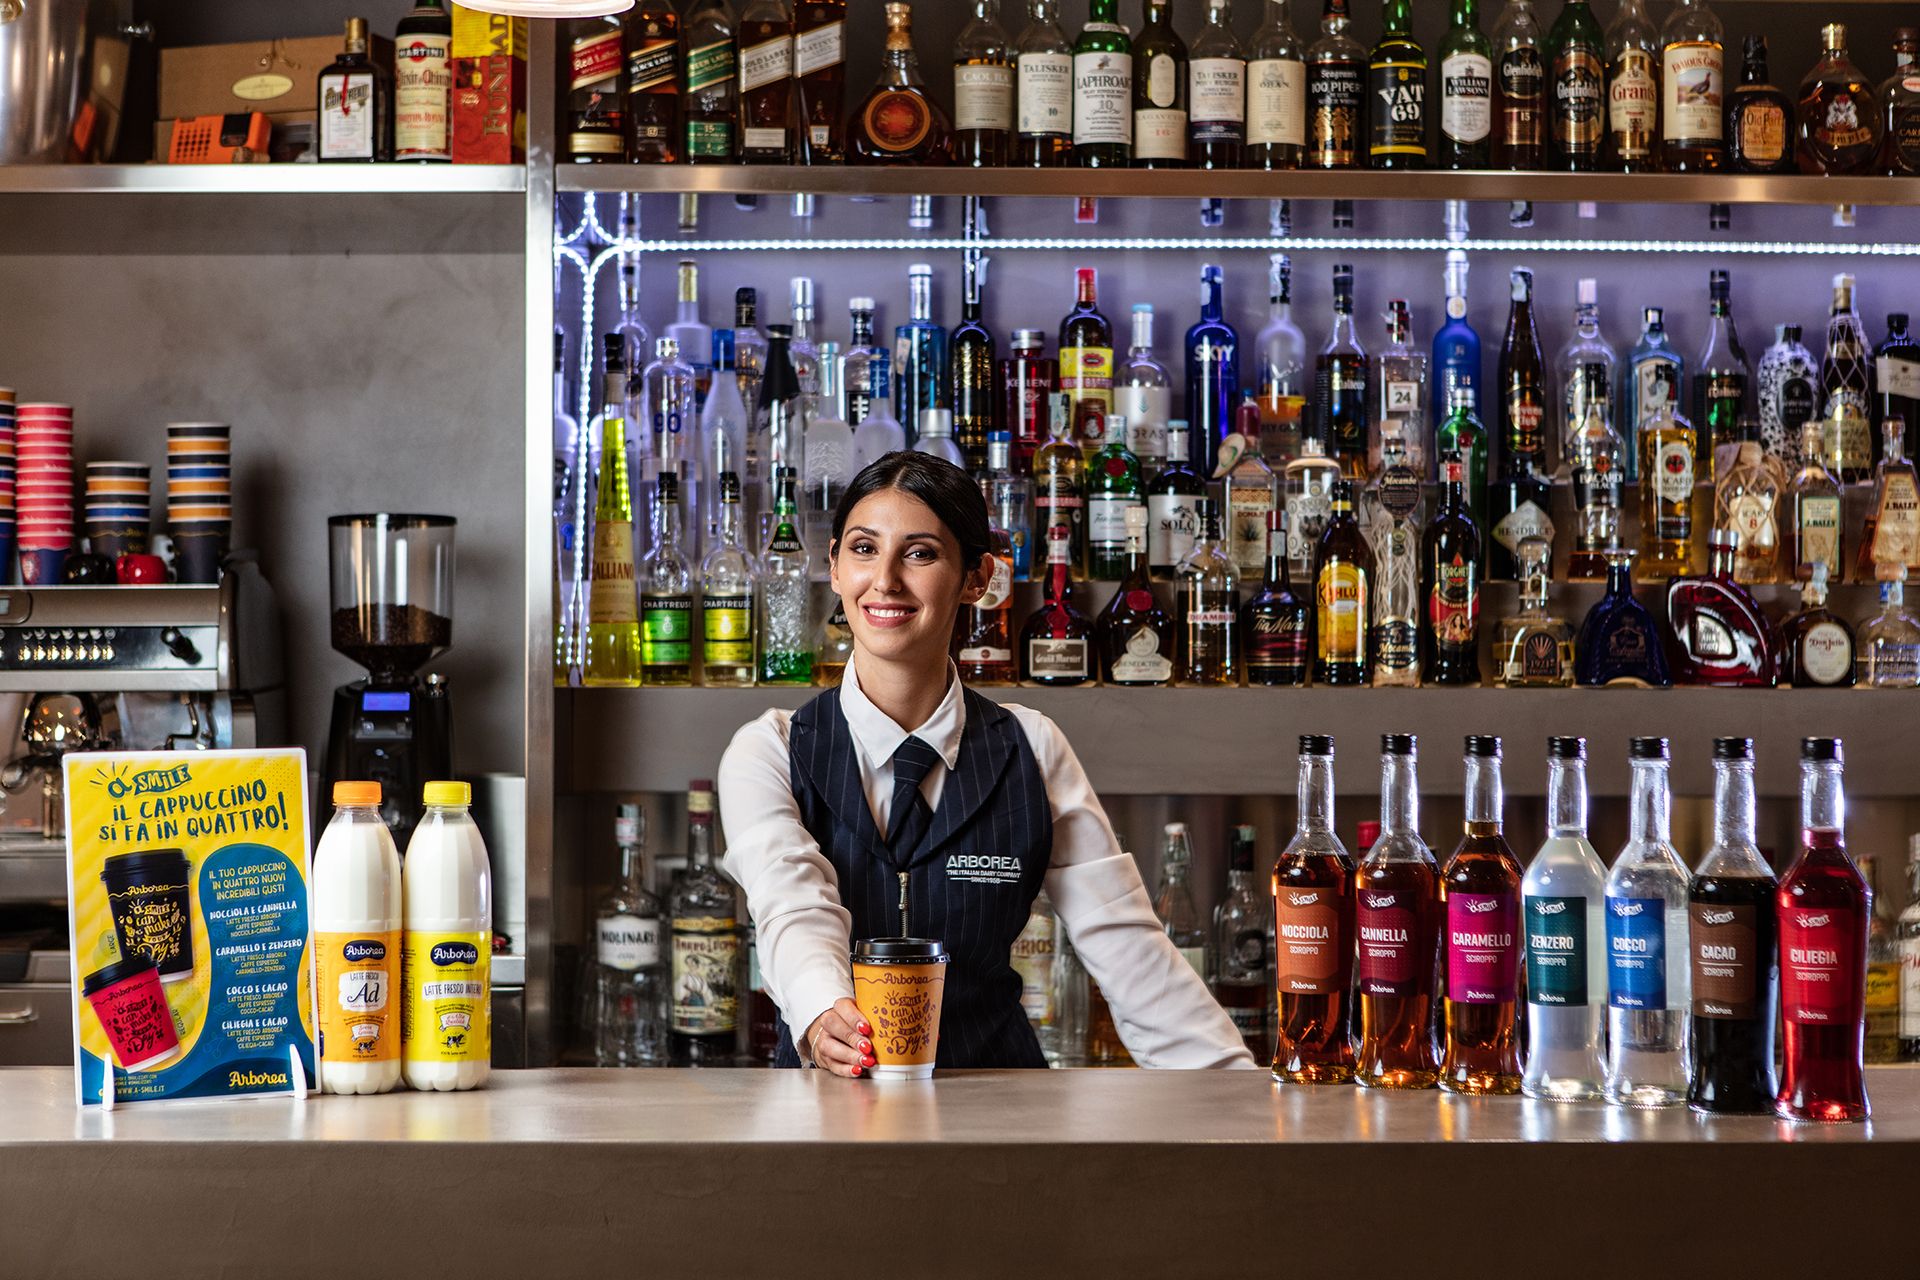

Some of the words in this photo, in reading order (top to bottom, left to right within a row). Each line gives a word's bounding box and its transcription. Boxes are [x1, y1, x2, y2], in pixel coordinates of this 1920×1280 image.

[1023, 64, 1070, 74] TALISKER
[1311, 82, 1328, 94] 100
[1450, 77, 1487, 88] WILLIAM
[1378, 85, 1424, 106] VAT
[1390, 104, 1421, 122] 69
[1194, 344, 1235, 361] SKYY
[1394, 391, 1412, 404] 24
[1805, 519, 1836, 528] J.BALLY
[643, 600, 693, 610] CHARTREUSE
[125, 823, 150, 841] FA
[187, 791, 289, 838] QUATTRO!
[946, 855, 1021, 870] ARBOREA
[219, 867, 236, 878] TUO
[238, 862, 287, 876] CAPPUCCINO
[212, 881, 221, 890] IN
[223, 876, 260, 889] QUATTRO
[261, 872, 286, 884] NUOVI
[127, 884, 171, 896] Arborea
[216, 887, 260, 900] INCREDIBILI
[262, 883, 285, 895] GUSTI
[209, 906, 249, 920] NOCCIOLA
[251, 905, 256, 914] E
[257, 900, 298, 913] CANNELLA
[1282, 924, 1329, 940] NOCCIOLA
[1361, 926, 1408, 942] CANNELLA
[1452, 932, 1511, 947] CARAMELLO
[1531, 934, 1574, 950] ZENZERO
[1613, 937, 1646, 952] COCCO
[215, 943, 261, 957] CARAMELLO
[262, 942, 267, 951] E
[268, 938, 303, 950] ZENZERO
[345, 944, 385, 956] Arborea
[433, 947, 477, 960] Arborea
[1289, 945, 1319, 955] SCIROPPO
[1368, 948, 1396, 958] SCIROPPO
[1701, 945, 1737, 961] CACAO
[1465, 954, 1498, 964] SCIROPPO
[1537, 957, 1567, 966] SCIROPPO
[1790, 948, 1838, 965] CILIEGIA
[1615, 959, 1645, 969] SCIROPPO
[884, 973, 929, 985] Arborea
[1703, 967, 1735, 978] SCIROPPO
[1796, 970, 1830, 982] SCIROPPO
[226, 986, 254, 996] COCCO
[262, 982, 288, 992] CACAO
[424, 984, 442, 996] LATTE
[443, 983, 464, 995] FRESCO
[891, 1006, 909, 1018] can
[222, 1019, 254, 1030] CILIEGIA
[255, 1019, 260, 1027] E
[262, 1016, 288, 1027] CACAO
[229, 1070, 288, 1087] Arborea
